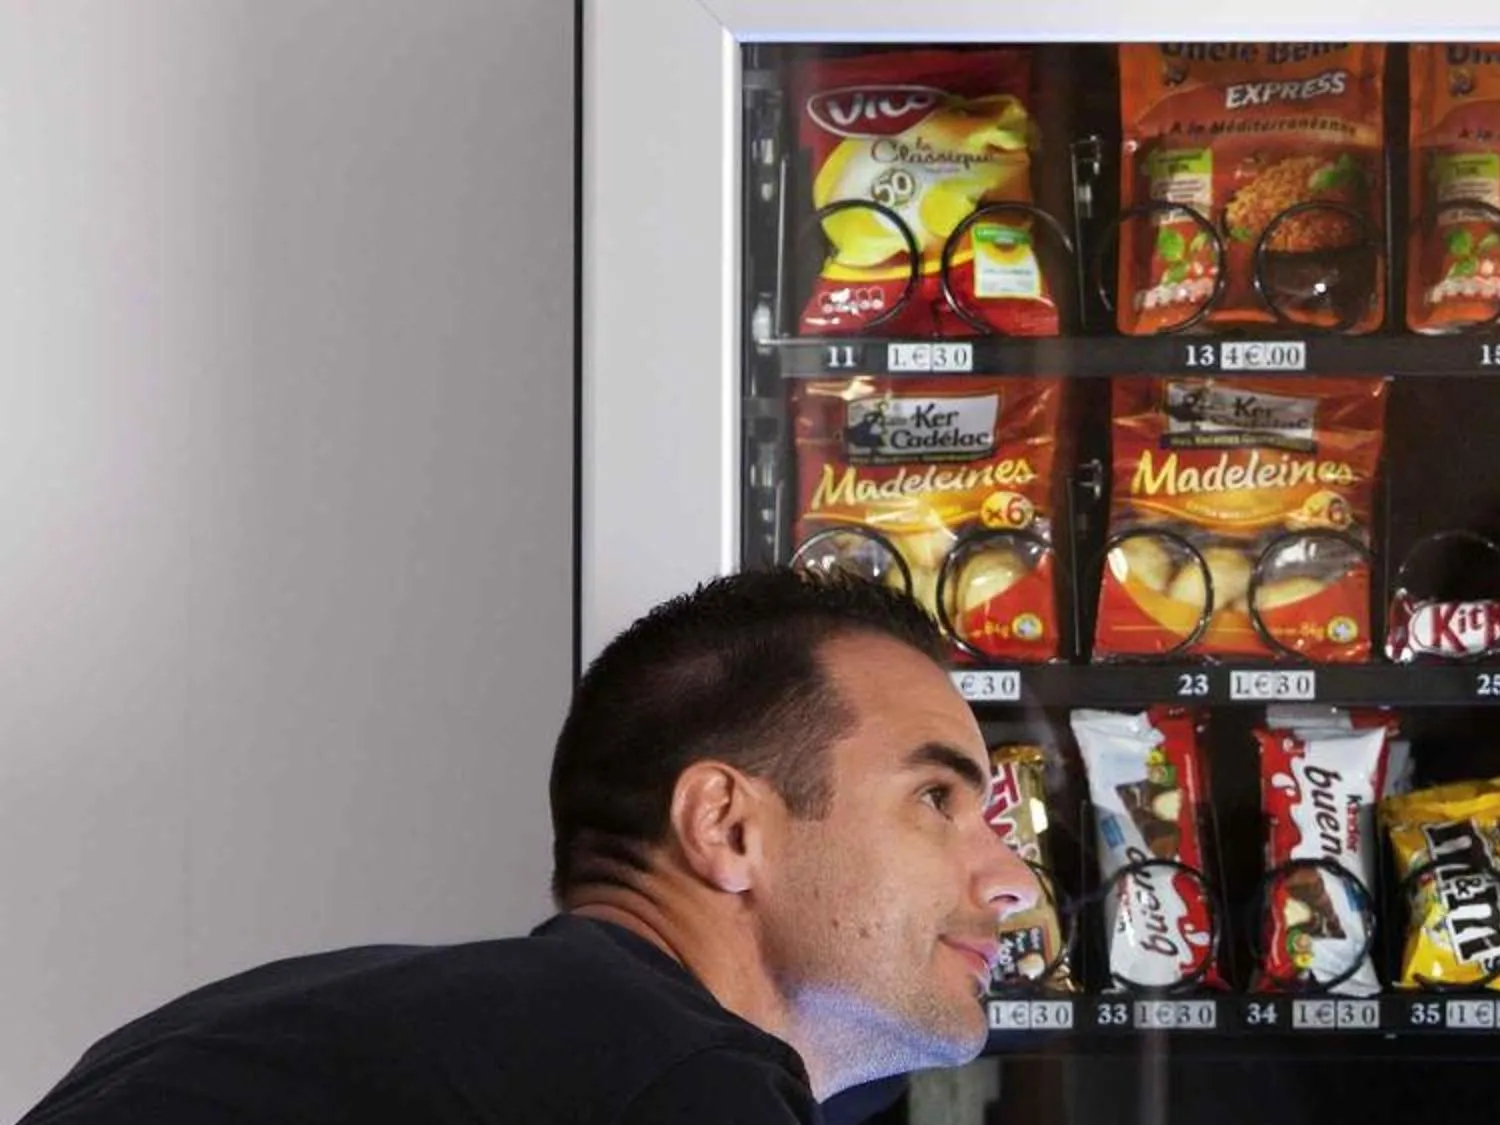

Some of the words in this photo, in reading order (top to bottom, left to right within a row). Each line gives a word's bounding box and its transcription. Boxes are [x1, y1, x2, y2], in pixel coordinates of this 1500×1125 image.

[1225, 71, 1347, 110] EXPRESS
[828, 346, 856, 368] 11
[1185, 345, 1216, 367] 13
[910, 403, 959, 429] Ker
[889, 428, 990, 450] Cadélac
[811, 457, 1038, 510] Madeleines
[1131, 449, 1356, 496] Madeleines
[961, 674, 1015, 696] €30
[1178, 673, 1209, 696] 23
[1098, 1004, 1128, 1025] 33
[1247, 1003, 1277, 1025] 34
[1411, 1003, 1440, 1025] 35
